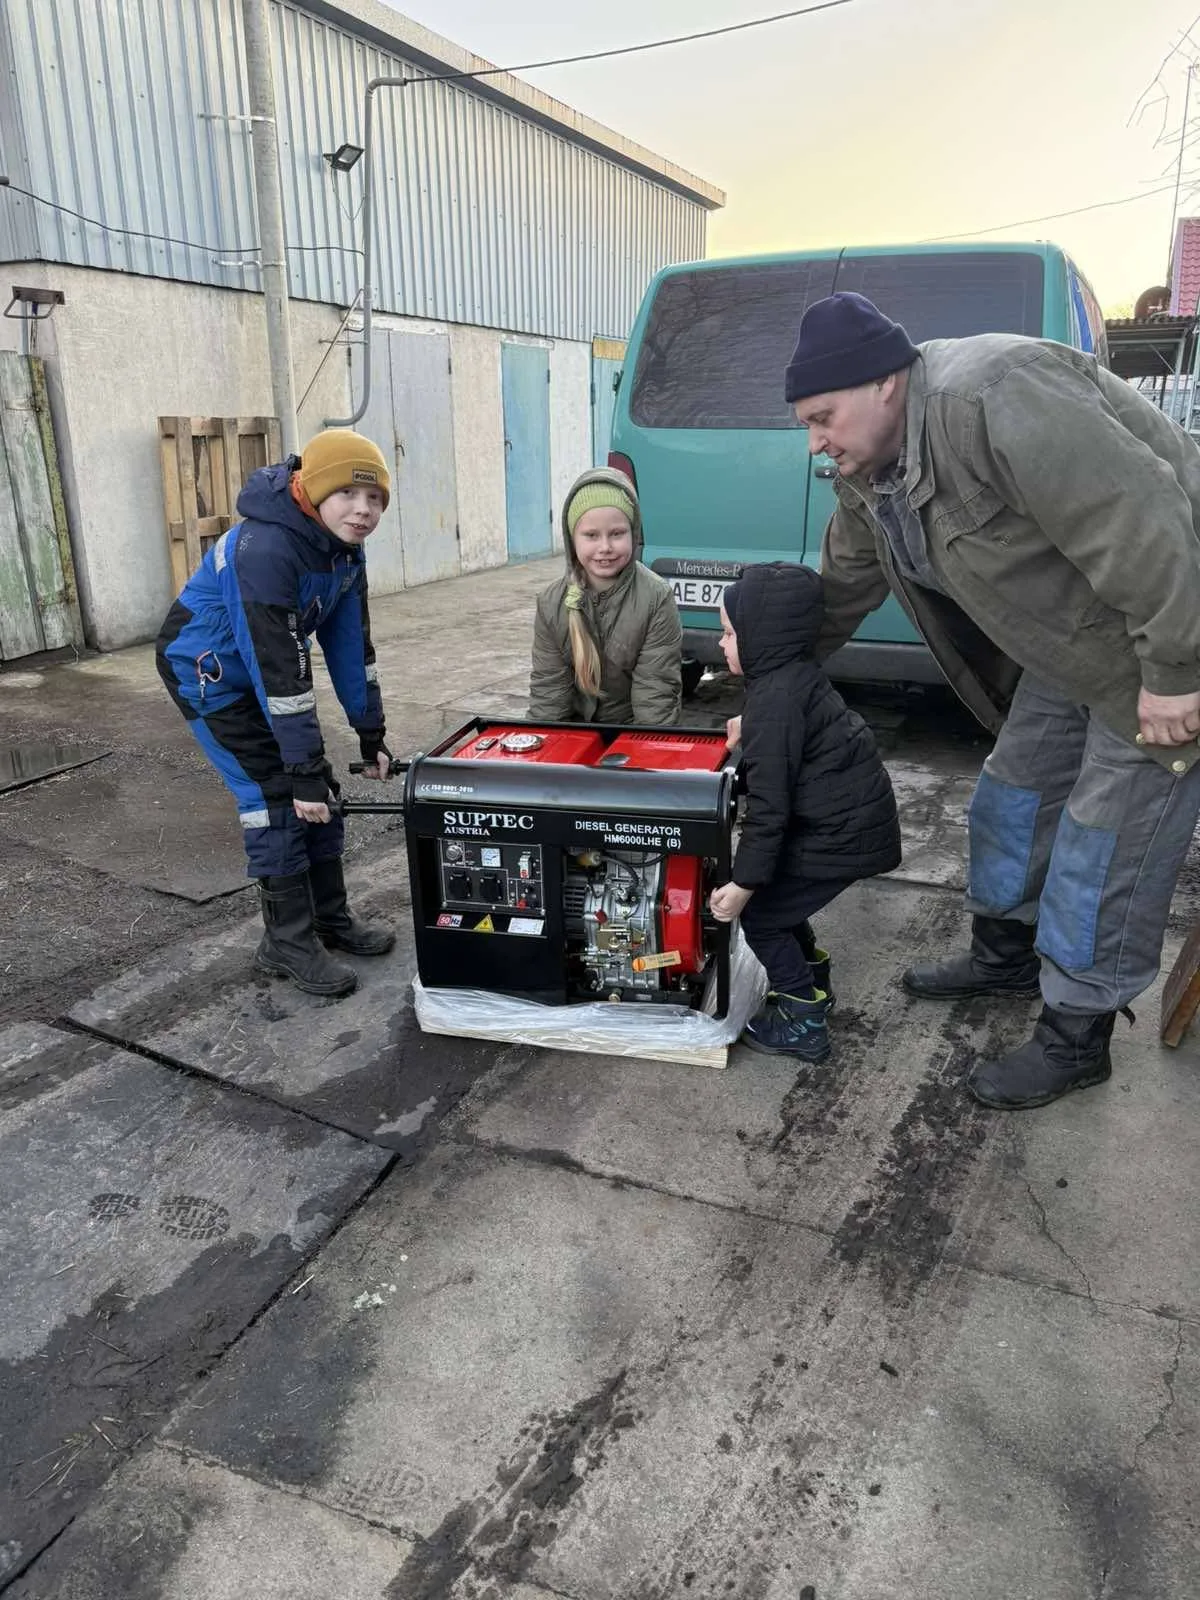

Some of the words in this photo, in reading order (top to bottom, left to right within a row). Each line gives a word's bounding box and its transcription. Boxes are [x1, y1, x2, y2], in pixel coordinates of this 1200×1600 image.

[673, 582, 697, 602] AE
[701, 584, 727, 604] 87
[443, 810, 534, 830] SUPTEC
[575, 820, 613, 832] DIESEL
[614, 823, 681, 836] GENERATOR
[444, 826, 490, 836] AUSTRIA
[604, 834, 662, 847] HM6000LHE
[666, 838, 682, 849] (B)
